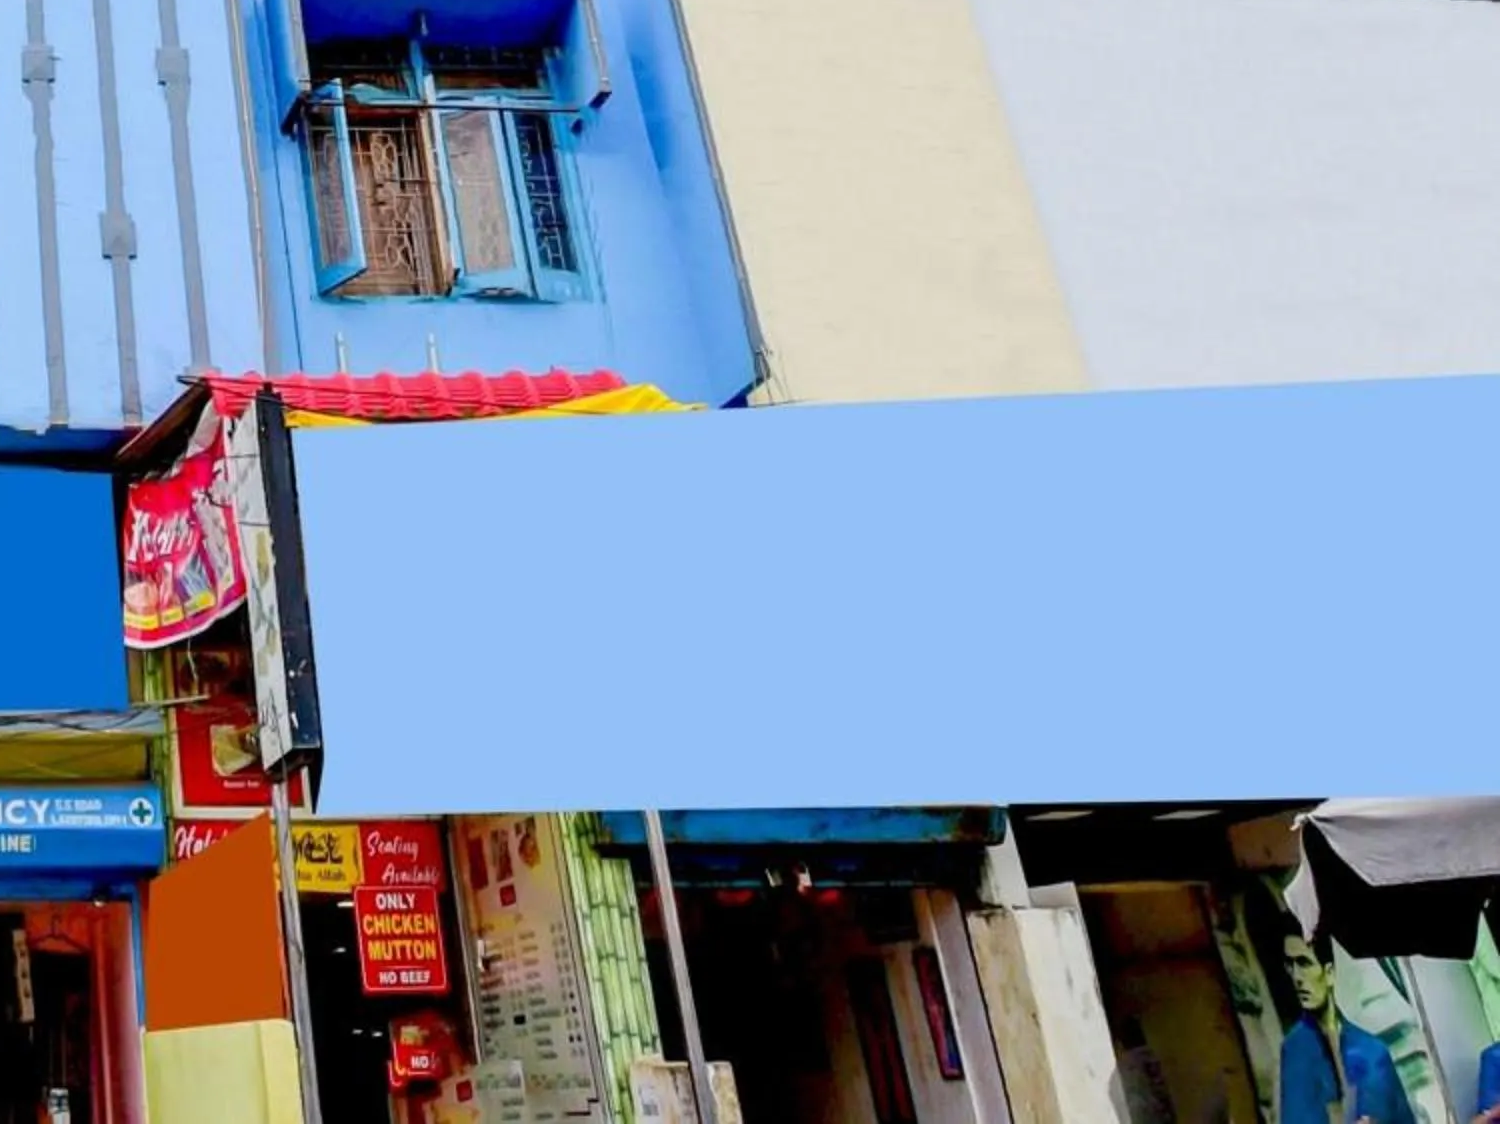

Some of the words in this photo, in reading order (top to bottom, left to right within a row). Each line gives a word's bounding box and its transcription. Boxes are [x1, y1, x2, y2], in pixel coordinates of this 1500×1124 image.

[367, 830, 419, 863] Seating
[375, 892, 415, 910] ONLY
[362, 913, 437, 935] CHICKEN
[367, 939, 437, 961] MUTTON
[379, 971, 398, 985] NO
